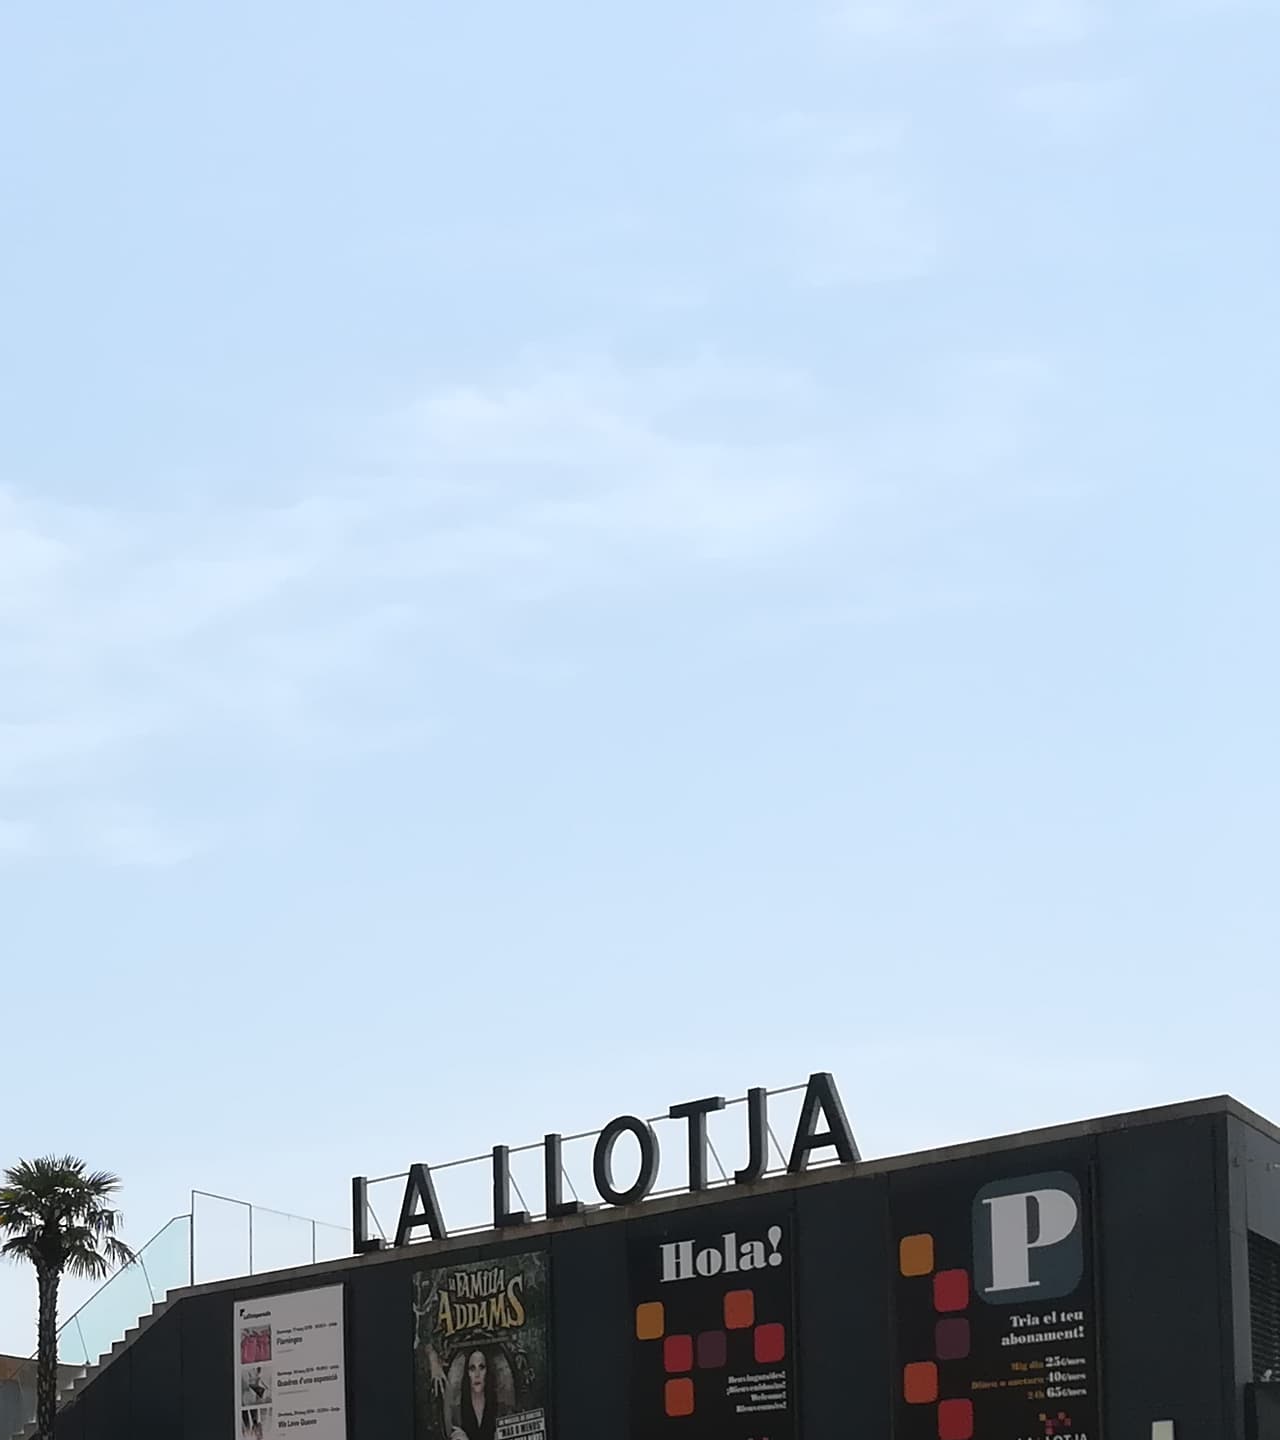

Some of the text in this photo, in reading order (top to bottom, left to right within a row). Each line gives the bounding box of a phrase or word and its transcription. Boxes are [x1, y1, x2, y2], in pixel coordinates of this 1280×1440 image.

[352, 1072, 862, 1254] LA LLOTJA
[659, 1225, 782, 1283] Hola!
[982, 1188, 1078, 1292] P
[433, 1274, 525, 1337] ADDAMS
[454, 1267, 505, 1299] FAMILIA
[1001, 1326, 1085, 1346] abonament!
[1010, 1310, 1084, 1328] Tria el teu
